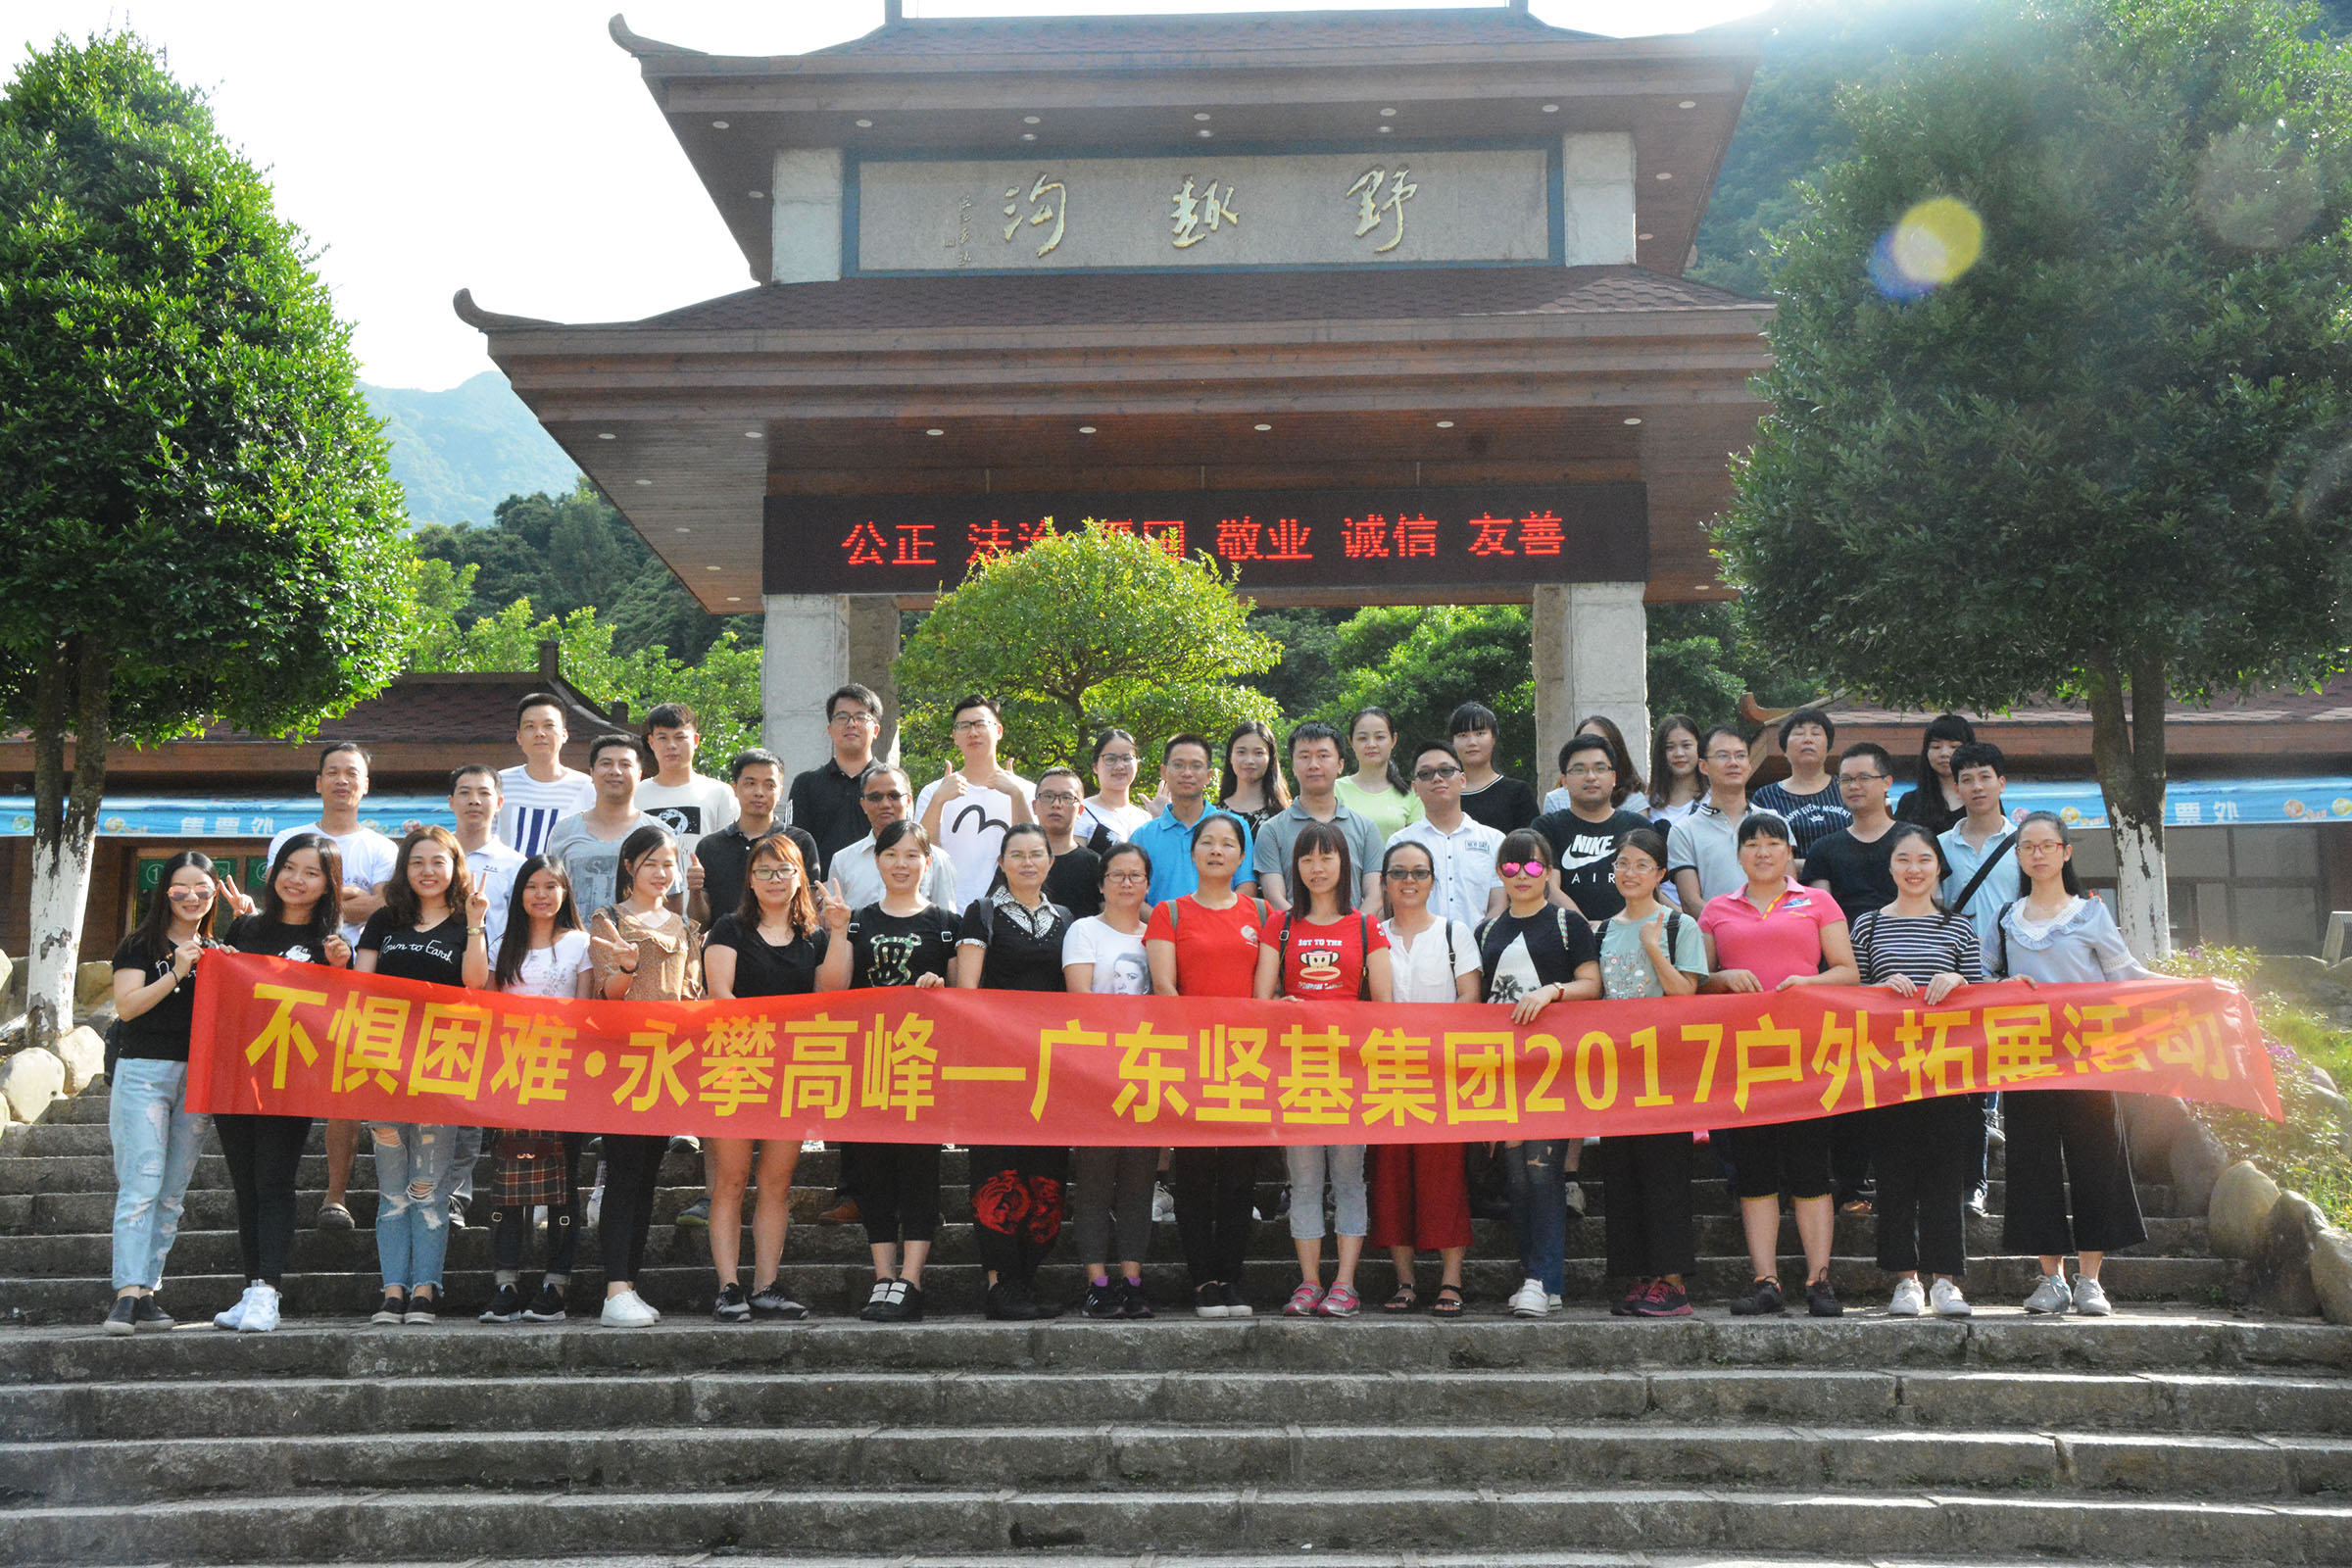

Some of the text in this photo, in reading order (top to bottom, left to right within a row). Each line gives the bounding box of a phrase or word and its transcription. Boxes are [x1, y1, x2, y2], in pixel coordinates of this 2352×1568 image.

[842, 521, 936, 564] 公正
[1216, 515, 1313, 560] 敬业
[1341, 514, 1438, 558] 诚信
[1468, 511, 1565, 556] 友善
[1822, 805, 1852, 819] MOMENT
[1571, 834, 1615, 856] NIKE
[1571, 872, 1616, 884] AIR
[409, 943, 424, 952] to
[425, 939, 453, 963] Earth
[1313, 938, 1325, 947] TO
